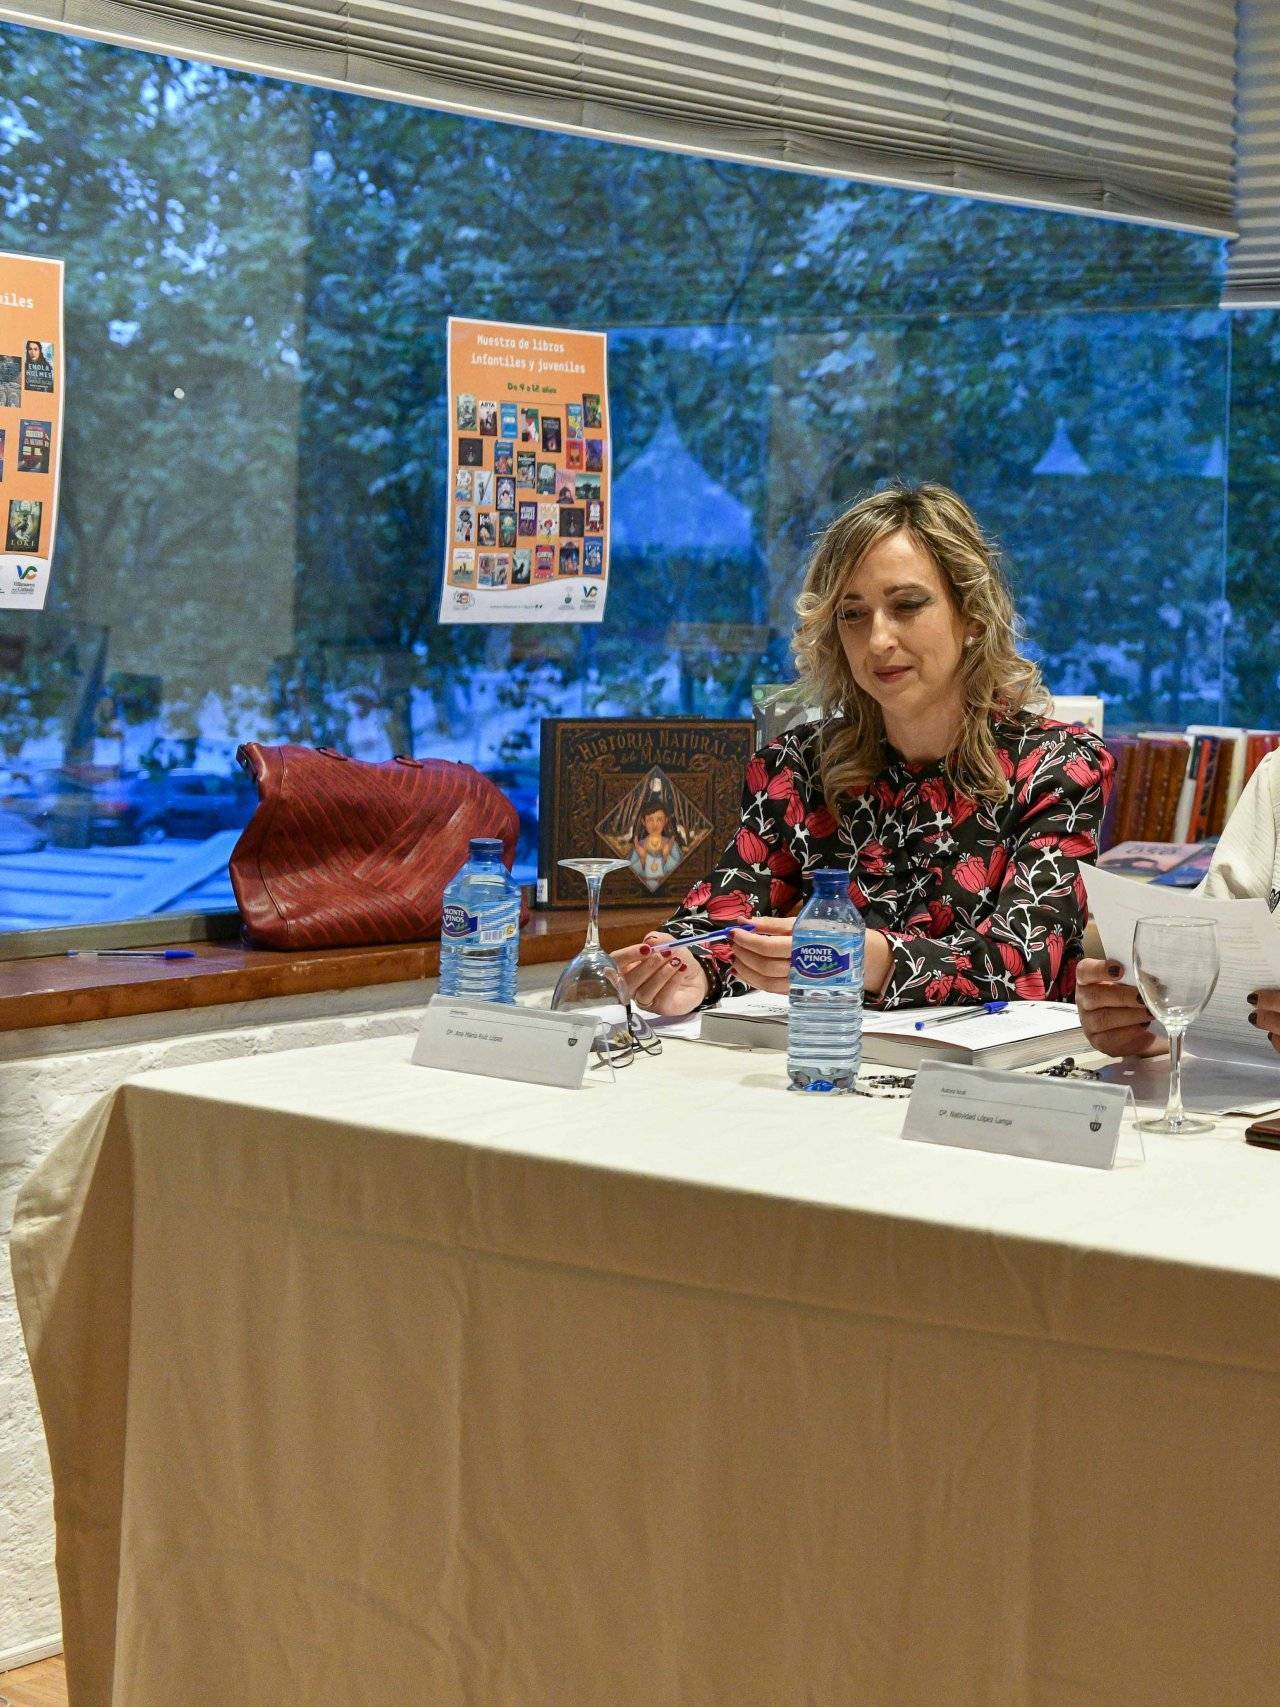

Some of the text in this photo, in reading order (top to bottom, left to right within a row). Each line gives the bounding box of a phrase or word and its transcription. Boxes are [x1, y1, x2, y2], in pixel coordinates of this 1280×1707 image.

[477, 334, 565, 353] Muestra de libros
[471, 353, 586, 374] infantiles y juveniles
[577, 730, 729, 760] HISTORIA NATURAL
[641, 750, 687, 767] MAGIA
[444, 908, 464, 916] MONTE
[445, 914, 465, 923] PINOS
[800, 948, 833, 956] MONTE
[804, 955, 833, 963] PINOS
